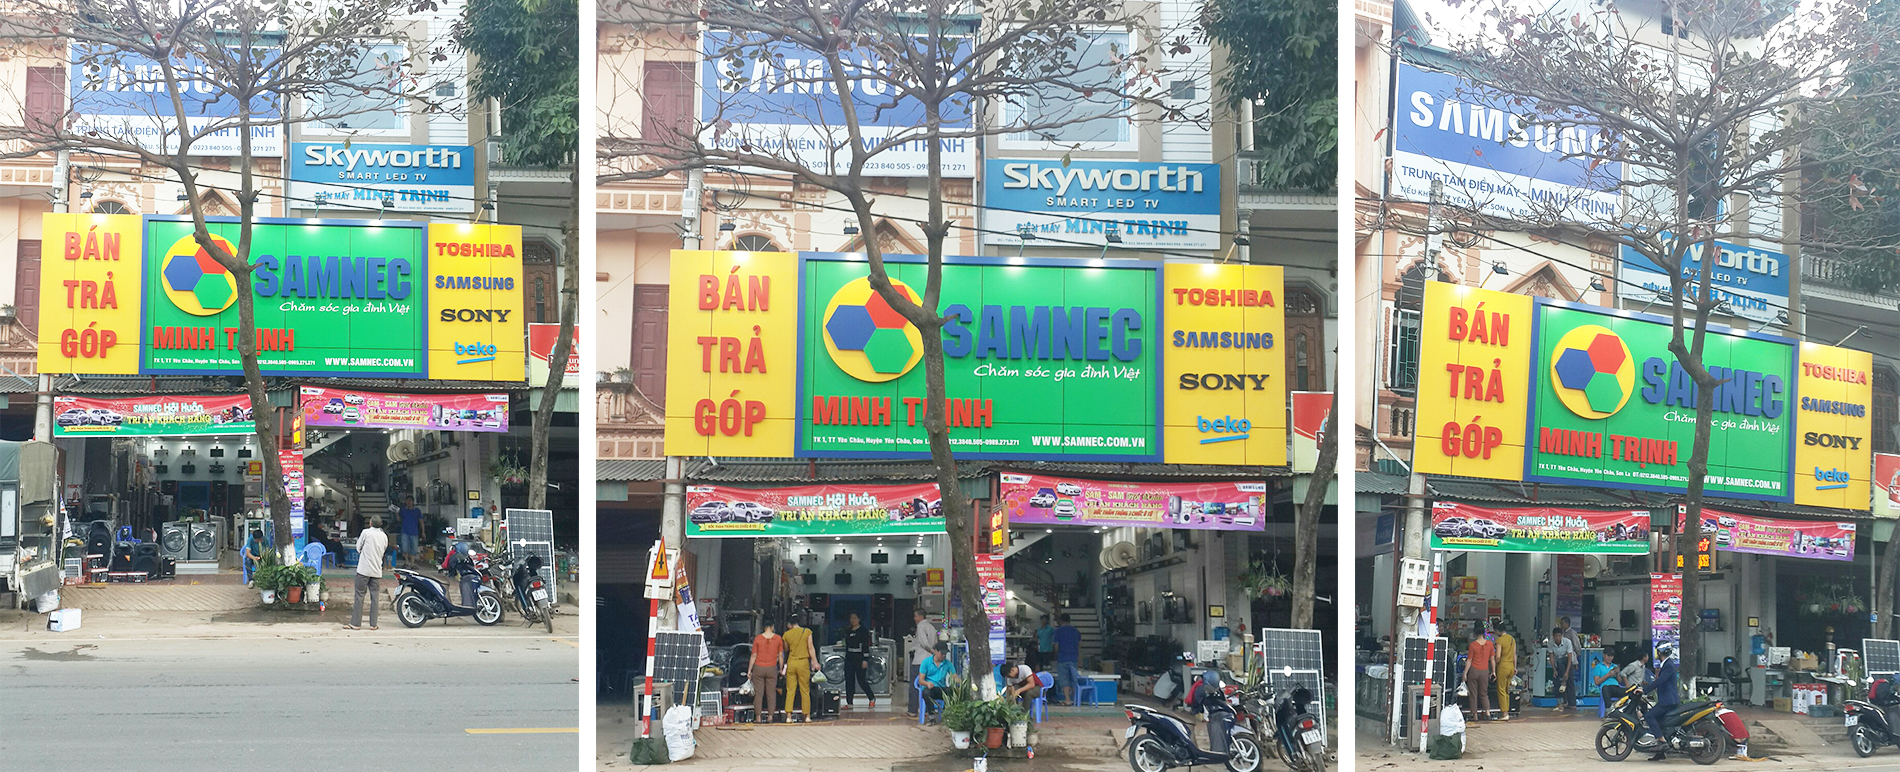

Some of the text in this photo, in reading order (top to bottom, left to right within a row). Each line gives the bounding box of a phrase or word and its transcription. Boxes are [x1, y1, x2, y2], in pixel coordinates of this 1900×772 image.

[135, 124, 159, 137] ĐIỆN
[235, 126, 275, 141] TỊNH
[786, 136, 816, 153] ĐIỆN
[305, 145, 460, 172] Skyworth
[881, 162, 895, 170] 840
[896, 162, 910, 170] 505
[338, 171, 427, 181] SMART LED TV
[1003, 163, 1203, 197] Skyworth
[334, 192, 350, 201] MÁY
[353, 188, 394, 201] MINH
[400, 189, 449, 205] TRỊNH
[1401, 165, 1441, 182] TRUNG
[1442, 173, 1466, 188] TÂM
[1468, 176, 1495, 193] ĐIỆN
[1496, 183, 1521, 199] MÁY
[1571, 194, 1615, 216] TRỊNH
[1046, 197, 1160, 209] SMART LED TV
[1490, 203, 1505, 211] SƠN
[1041, 222, 1061, 233] MÁY
[1065, 218, 1119, 234] MINH
[1124, 219, 1188, 239] TRỊNH
[64, 224, 121, 261] BÁN
[435, 242, 516, 258] TOSHIBA
[255, 255, 411, 301] SAMNEC
[435, 275, 514, 291] SAMSUNG
[1711, 273, 1749, 286] LED TV
[63, 271, 118, 309] TRẢ
[698, 265, 770, 312] BÁN
[1173, 288, 1275, 308] TOSHIBA
[279, 301, 411, 316] Chăm sóc gia đình Việt
[1720, 291, 1768, 312] TRỊNH
[440, 308, 512, 323] SONY
[1448, 301, 1510, 347] BÁN
[61, 321, 117, 358] GÓP
[154, 326, 294, 356] MINH TỊNH
[942, 303, 1142, 362] SAMNEC
[1173, 330, 1274, 350] SAMSUNG
[454, 341, 497, 356] beko
[696, 325, 767, 374] TRẢ
[325, 357, 414, 367] WWW.SAMNEC.COM.VN
[973, 362, 1141, 382] Chăm sóc gia đình Việt
[1179, 373, 1270, 391] SONY
[1446, 358, 1505, 402] TRẢ
[1802, 362, 1867, 386] TOSHIBA
[133, 403, 162, 413] SAMNEC
[694, 389, 767, 438] GÓP
[813, 396, 993, 433] MINH TỊNH
[1801, 396, 1866, 419] SAMSUNG
[1197, 415, 1252, 433] beko
[1663, 410, 1697, 424] Chăm
[1720, 419, 1737, 431] gia
[1761, 421, 1781, 436] Việt
[866, 437, 883, 446] Huyện
[1031, 435, 1145, 448] WWW.SAMNEC.COM.VN
[1441, 415, 1503, 459] GÓP
[1539, 426, 1678, 468] MINH TRỊNH
[1804, 432, 1863, 451] SONY
[1814, 466, 1850, 483] beko
[787, 495, 824, 506] SAMNEC
[779, 510, 797, 521] TRI
[1516, 515, 1546, 526] SAMNEC
